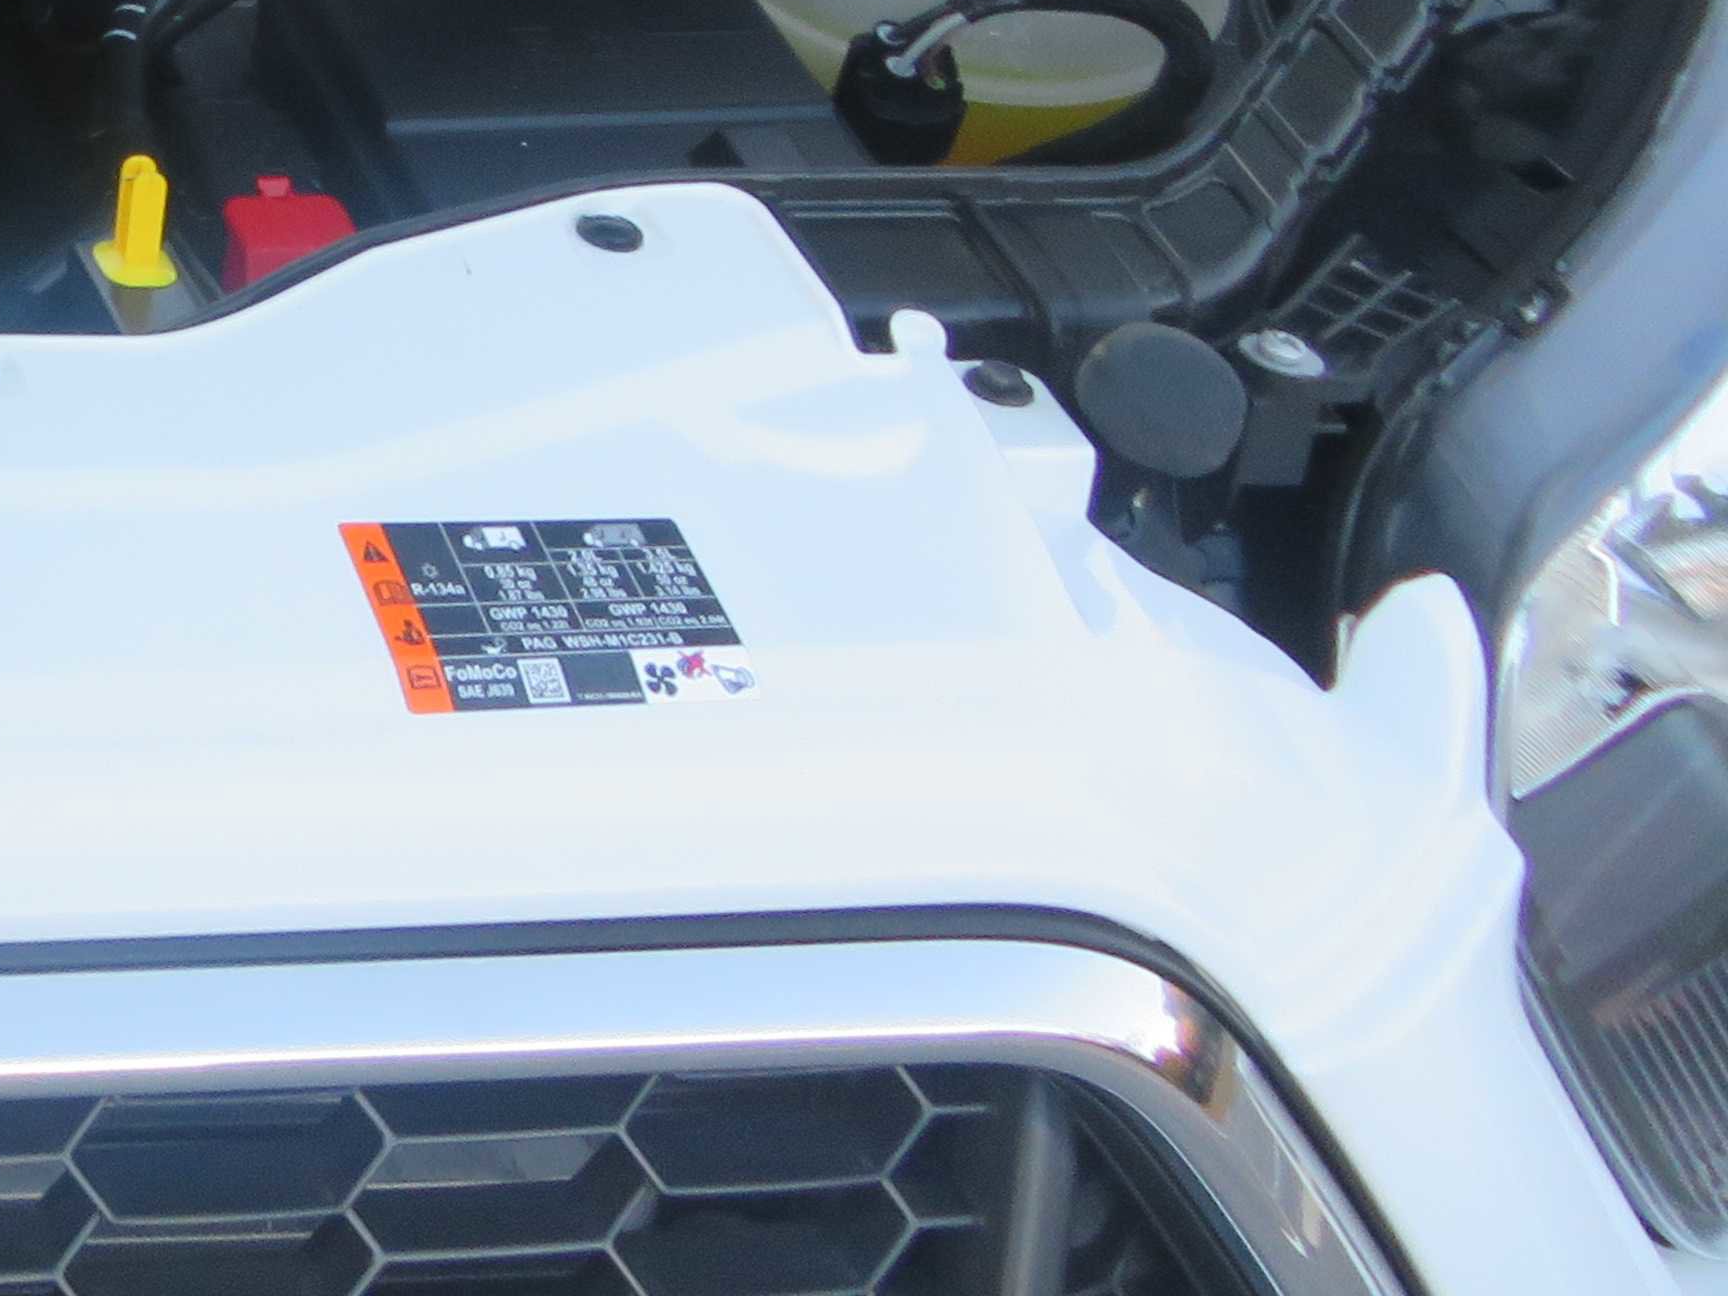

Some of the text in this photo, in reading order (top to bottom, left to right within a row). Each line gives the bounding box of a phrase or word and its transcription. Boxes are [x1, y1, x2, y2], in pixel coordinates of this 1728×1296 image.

[514, 564, 537, 581] kg
[595, 561, 619, 578] kg
[673, 559, 696, 577] kg
[410, 581, 466, 597] R-134a
[488, 606, 529, 621] GWP
[607, 602, 648, 617] GWP
[444, 662, 518, 681] FoMoCo
[457, 683, 485, 699] SAE
